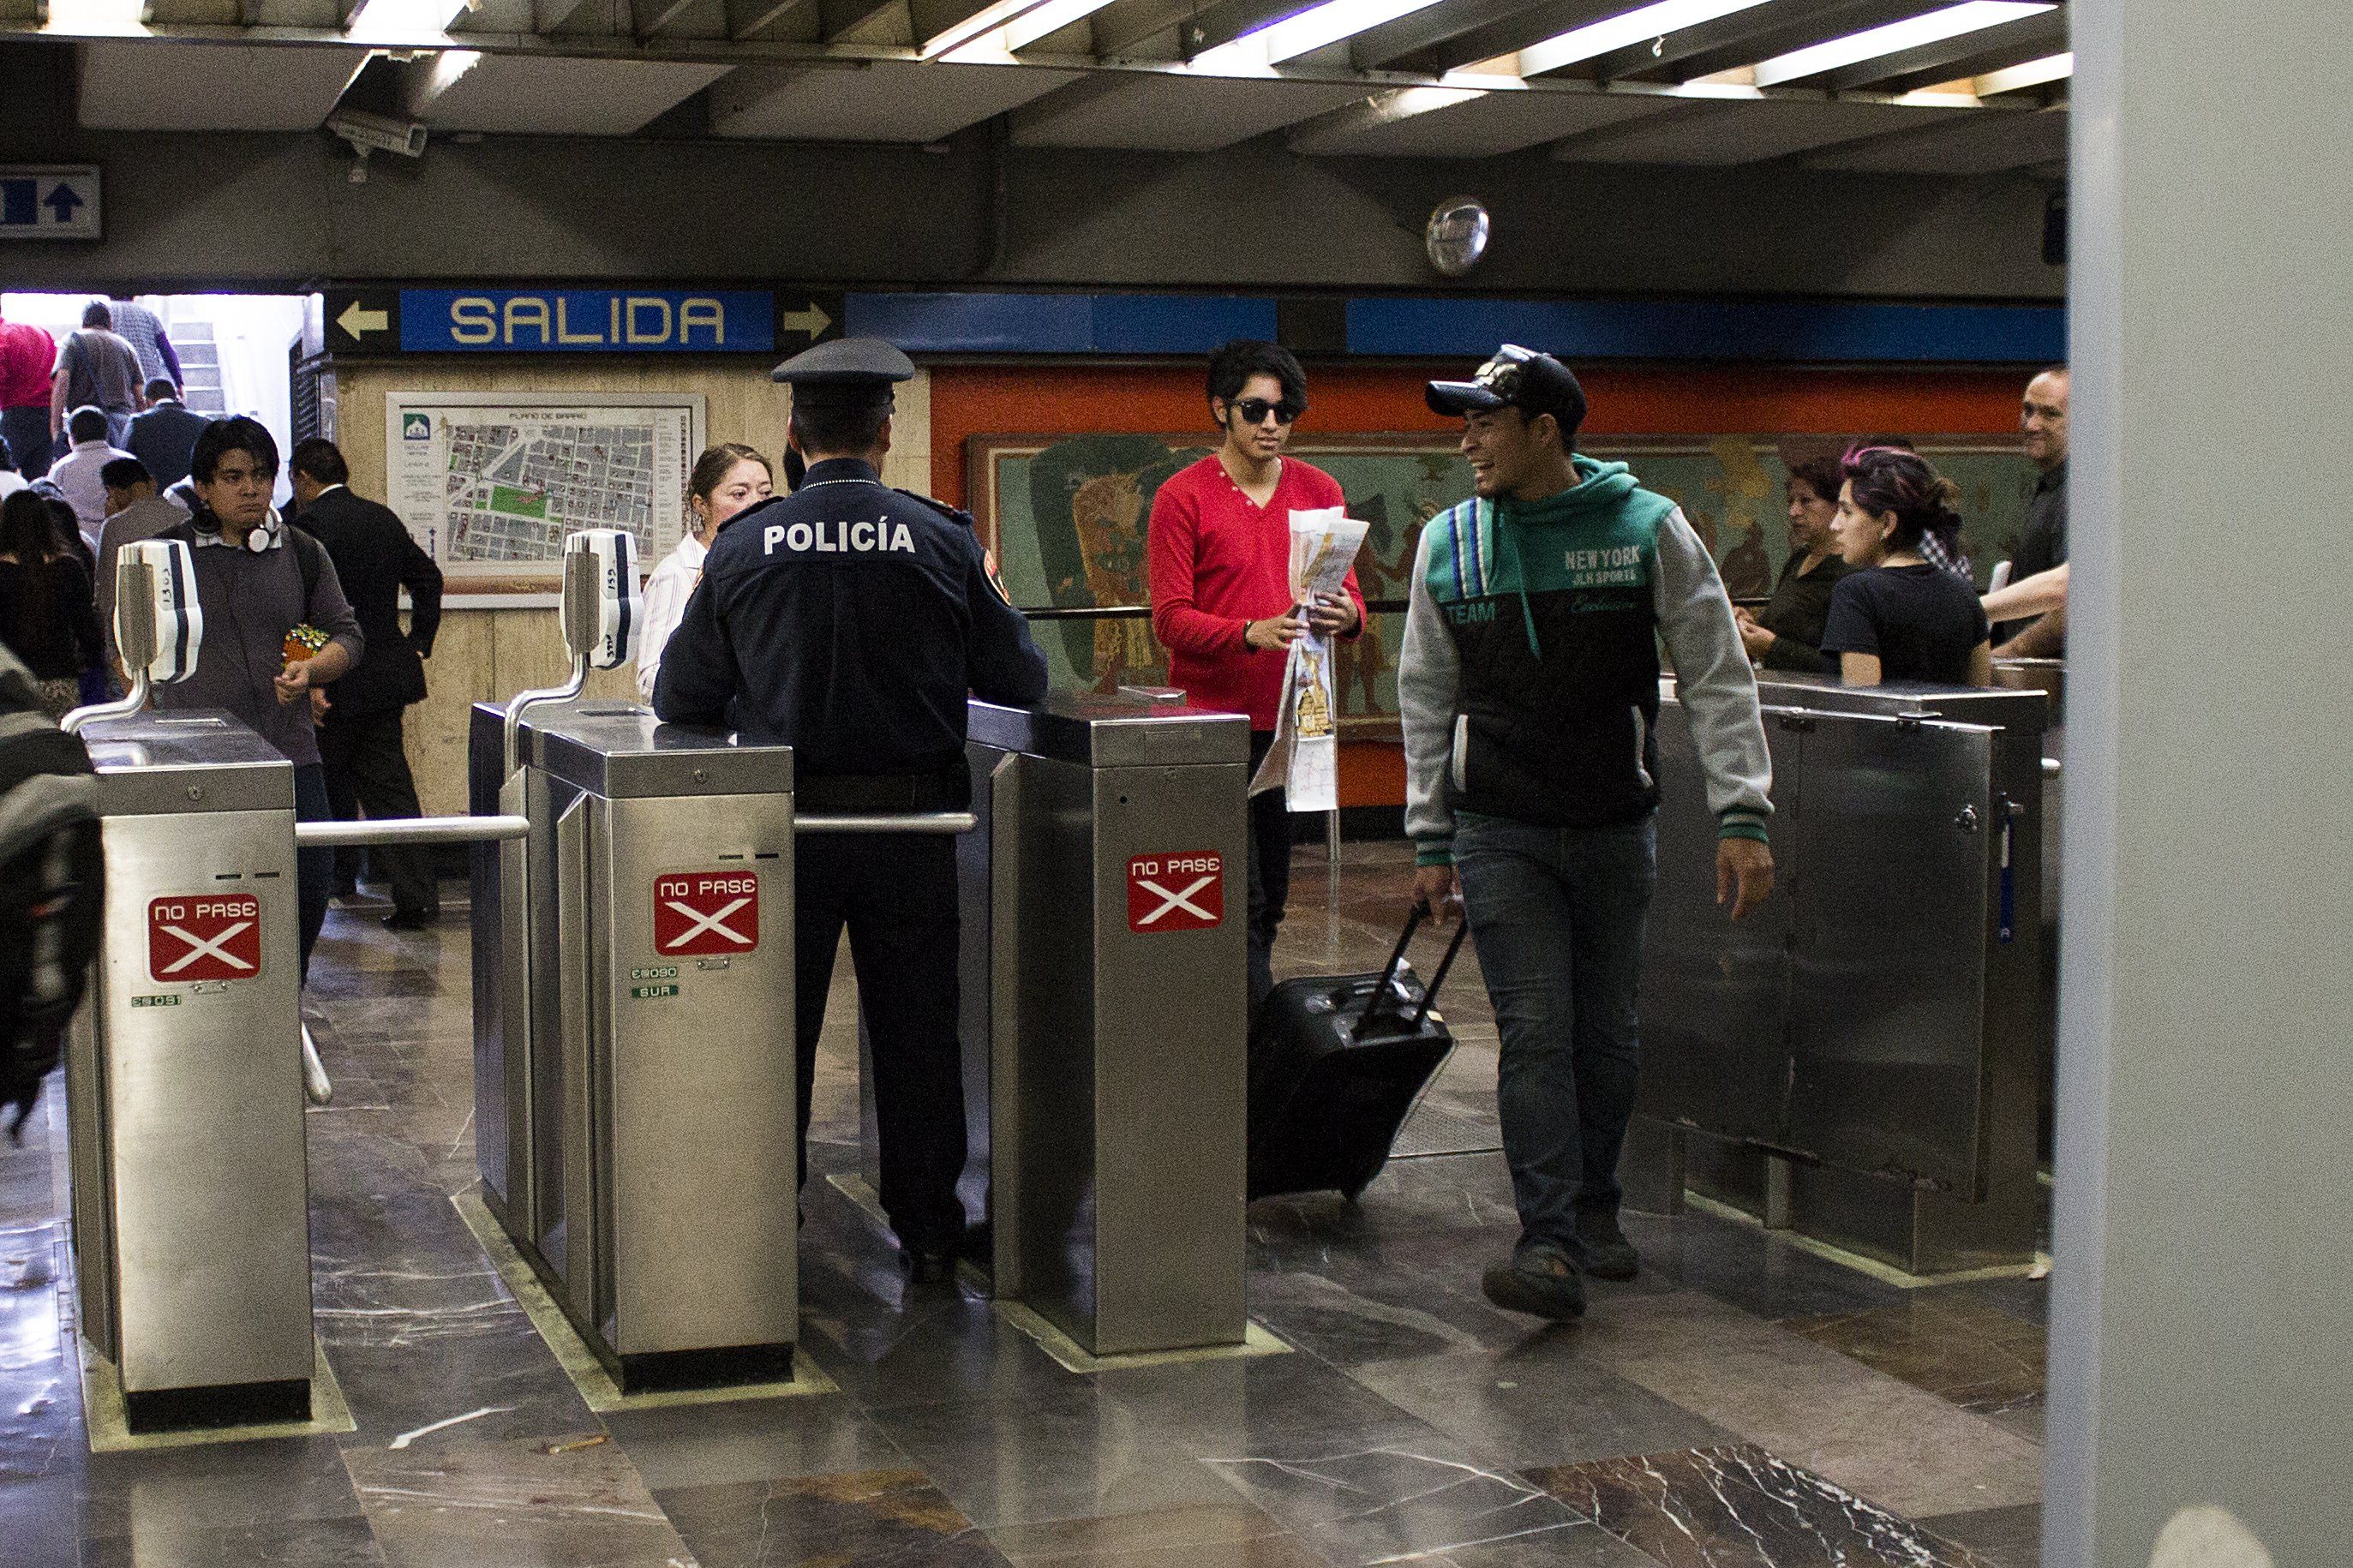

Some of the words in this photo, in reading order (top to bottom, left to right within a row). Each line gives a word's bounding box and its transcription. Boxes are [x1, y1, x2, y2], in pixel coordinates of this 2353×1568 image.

[450, 296, 725, 345] SALIDA
[763, 516, 916, 555] POLICÍA
[1565, 549, 1598, 571] NEW
[1600, 545, 1640, 567] YORK
[1446, 601, 1495, 625] TEAM
[1132, 861, 1159, 877] NO
[1167, 858, 1220, 875] PASE
[660, 882, 688, 897] NO
[699, 879, 756, 895] PASE
[154, 905, 185, 921] NO
[195, 902, 257, 919] PASE
[639, 986, 671, 998] SUR
